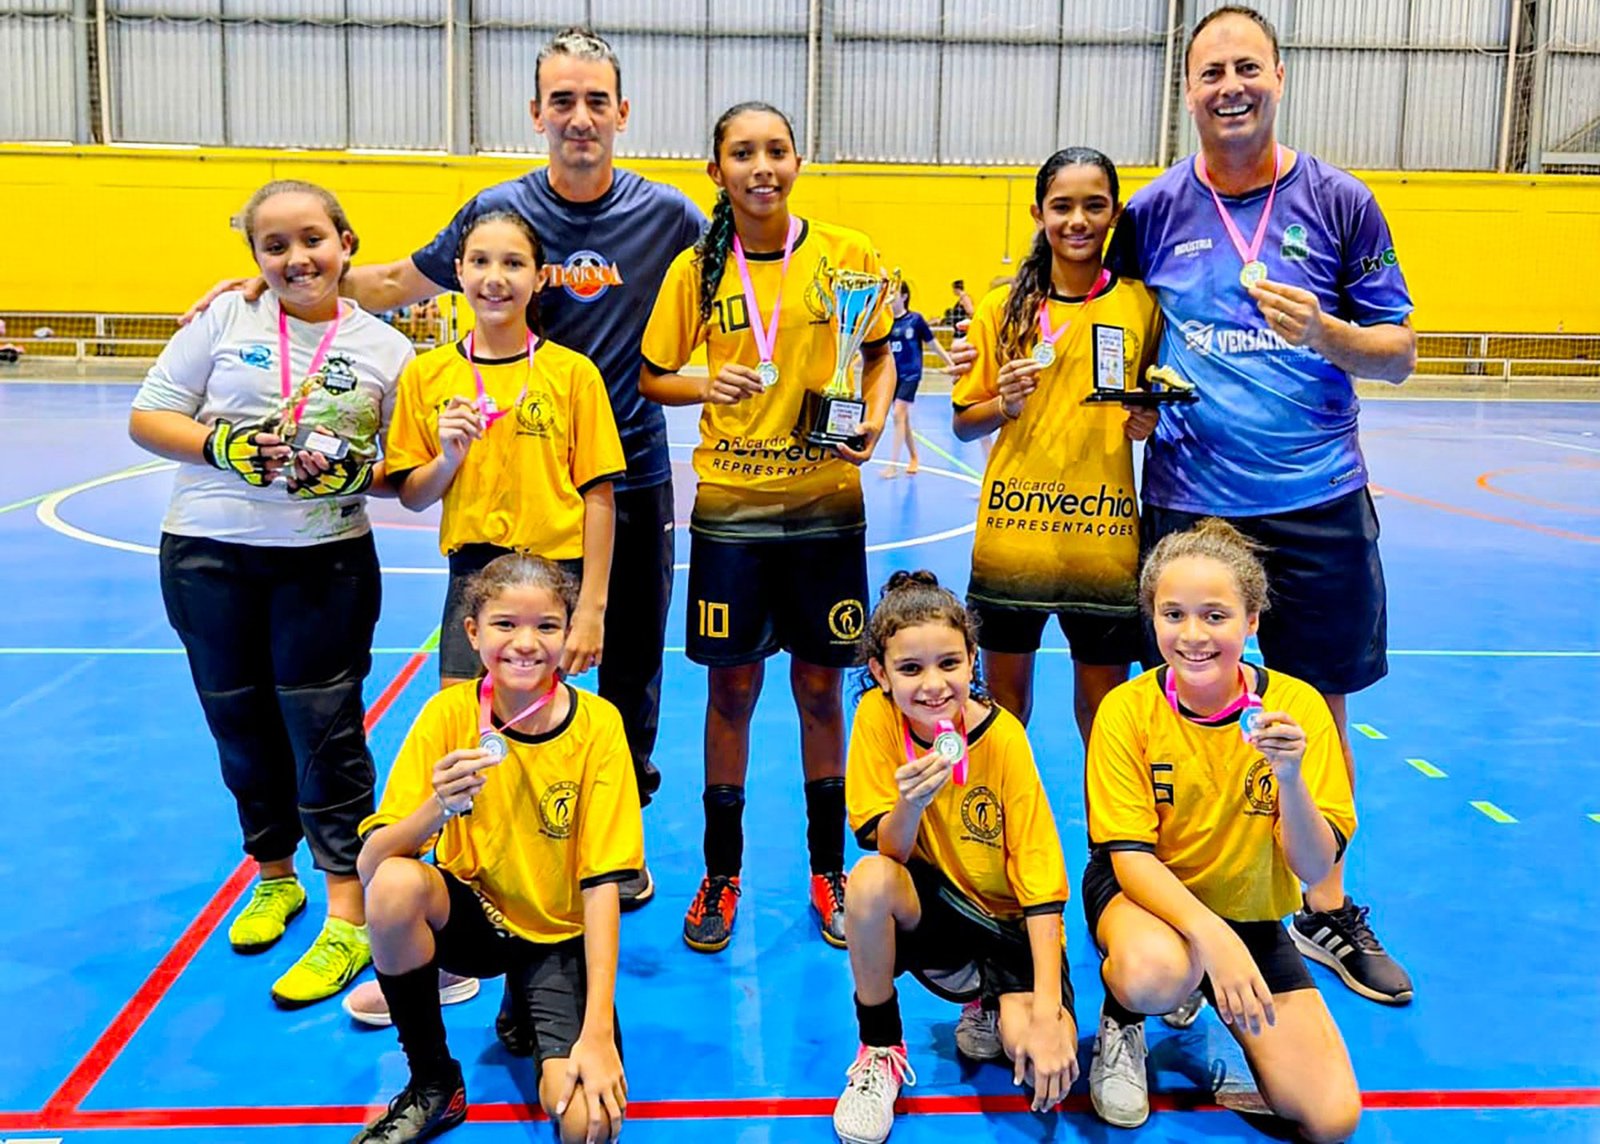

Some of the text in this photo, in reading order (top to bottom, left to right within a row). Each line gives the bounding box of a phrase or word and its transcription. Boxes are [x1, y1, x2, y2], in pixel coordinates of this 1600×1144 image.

[713, 293, 750, 334] 10
[731, 436, 787, 455] Ricardo
[988, 479, 1135, 518] Bonvechio
[1007, 477, 1066, 493] Ricardo
[986, 516, 1134, 536] REPRESENTAÇÕES
[698, 599, 729, 638] 10
